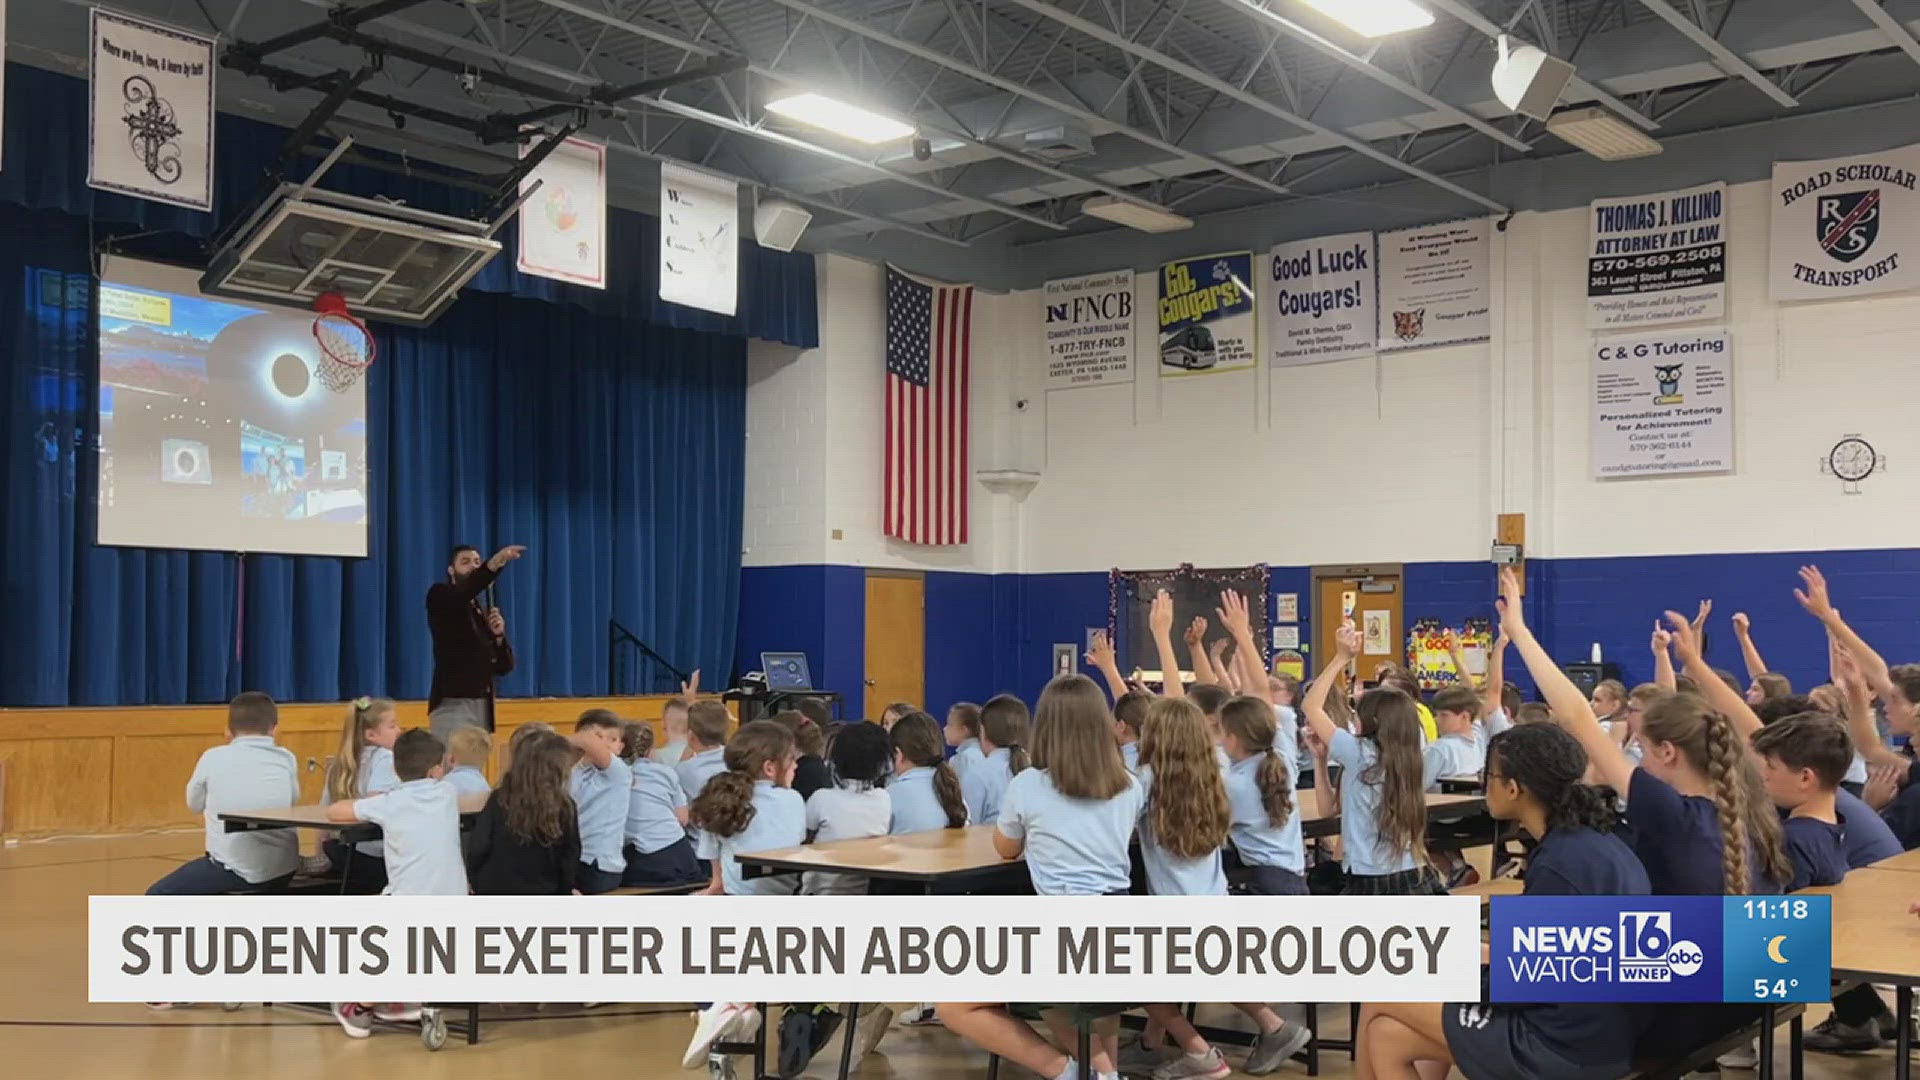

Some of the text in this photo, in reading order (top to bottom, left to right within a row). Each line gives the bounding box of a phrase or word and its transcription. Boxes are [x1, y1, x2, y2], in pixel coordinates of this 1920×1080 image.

[1780, 164, 1916, 207] ROAD SCHOLAR
[1596, 189, 1722, 233] THOMAS J. KILLINO
[1595, 224, 1720, 255] ATTORNEY AT LAW
[1272, 244, 1368, 281] Good Luck
[1592, 246, 1722, 272] 570-569.2508
[1793, 253, 1899, 287] TRANSPORT
[1165, 263, 1196, 299] Go,
[1610, 274, 1637, 285] Laurel
[1640, 271, 1666, 282] Street
[1709, 263, 1721, 272] PA
[1073, 291, 1131, 323] FNCB
[1159, 282, 1242, 326] Cougars!
[1279, 280, 1361, 319] Cougars!
[1050, 337, 1126, 354] 1-877-TRY-FNCB
[1297, 336, 1343, 346] Family Dentistry
[1598, 338, 1724, 360] C & G Tutoring
[1066, 358, 1098, 367] WYOMING
[1100, 355, 1127, 363] AVENUE
[1600, 406, 1722, 421] Personalized Tutoring
[1635, 418, 1712, 431] Achievement!
[1628, 433, 1664, 441] Contact
